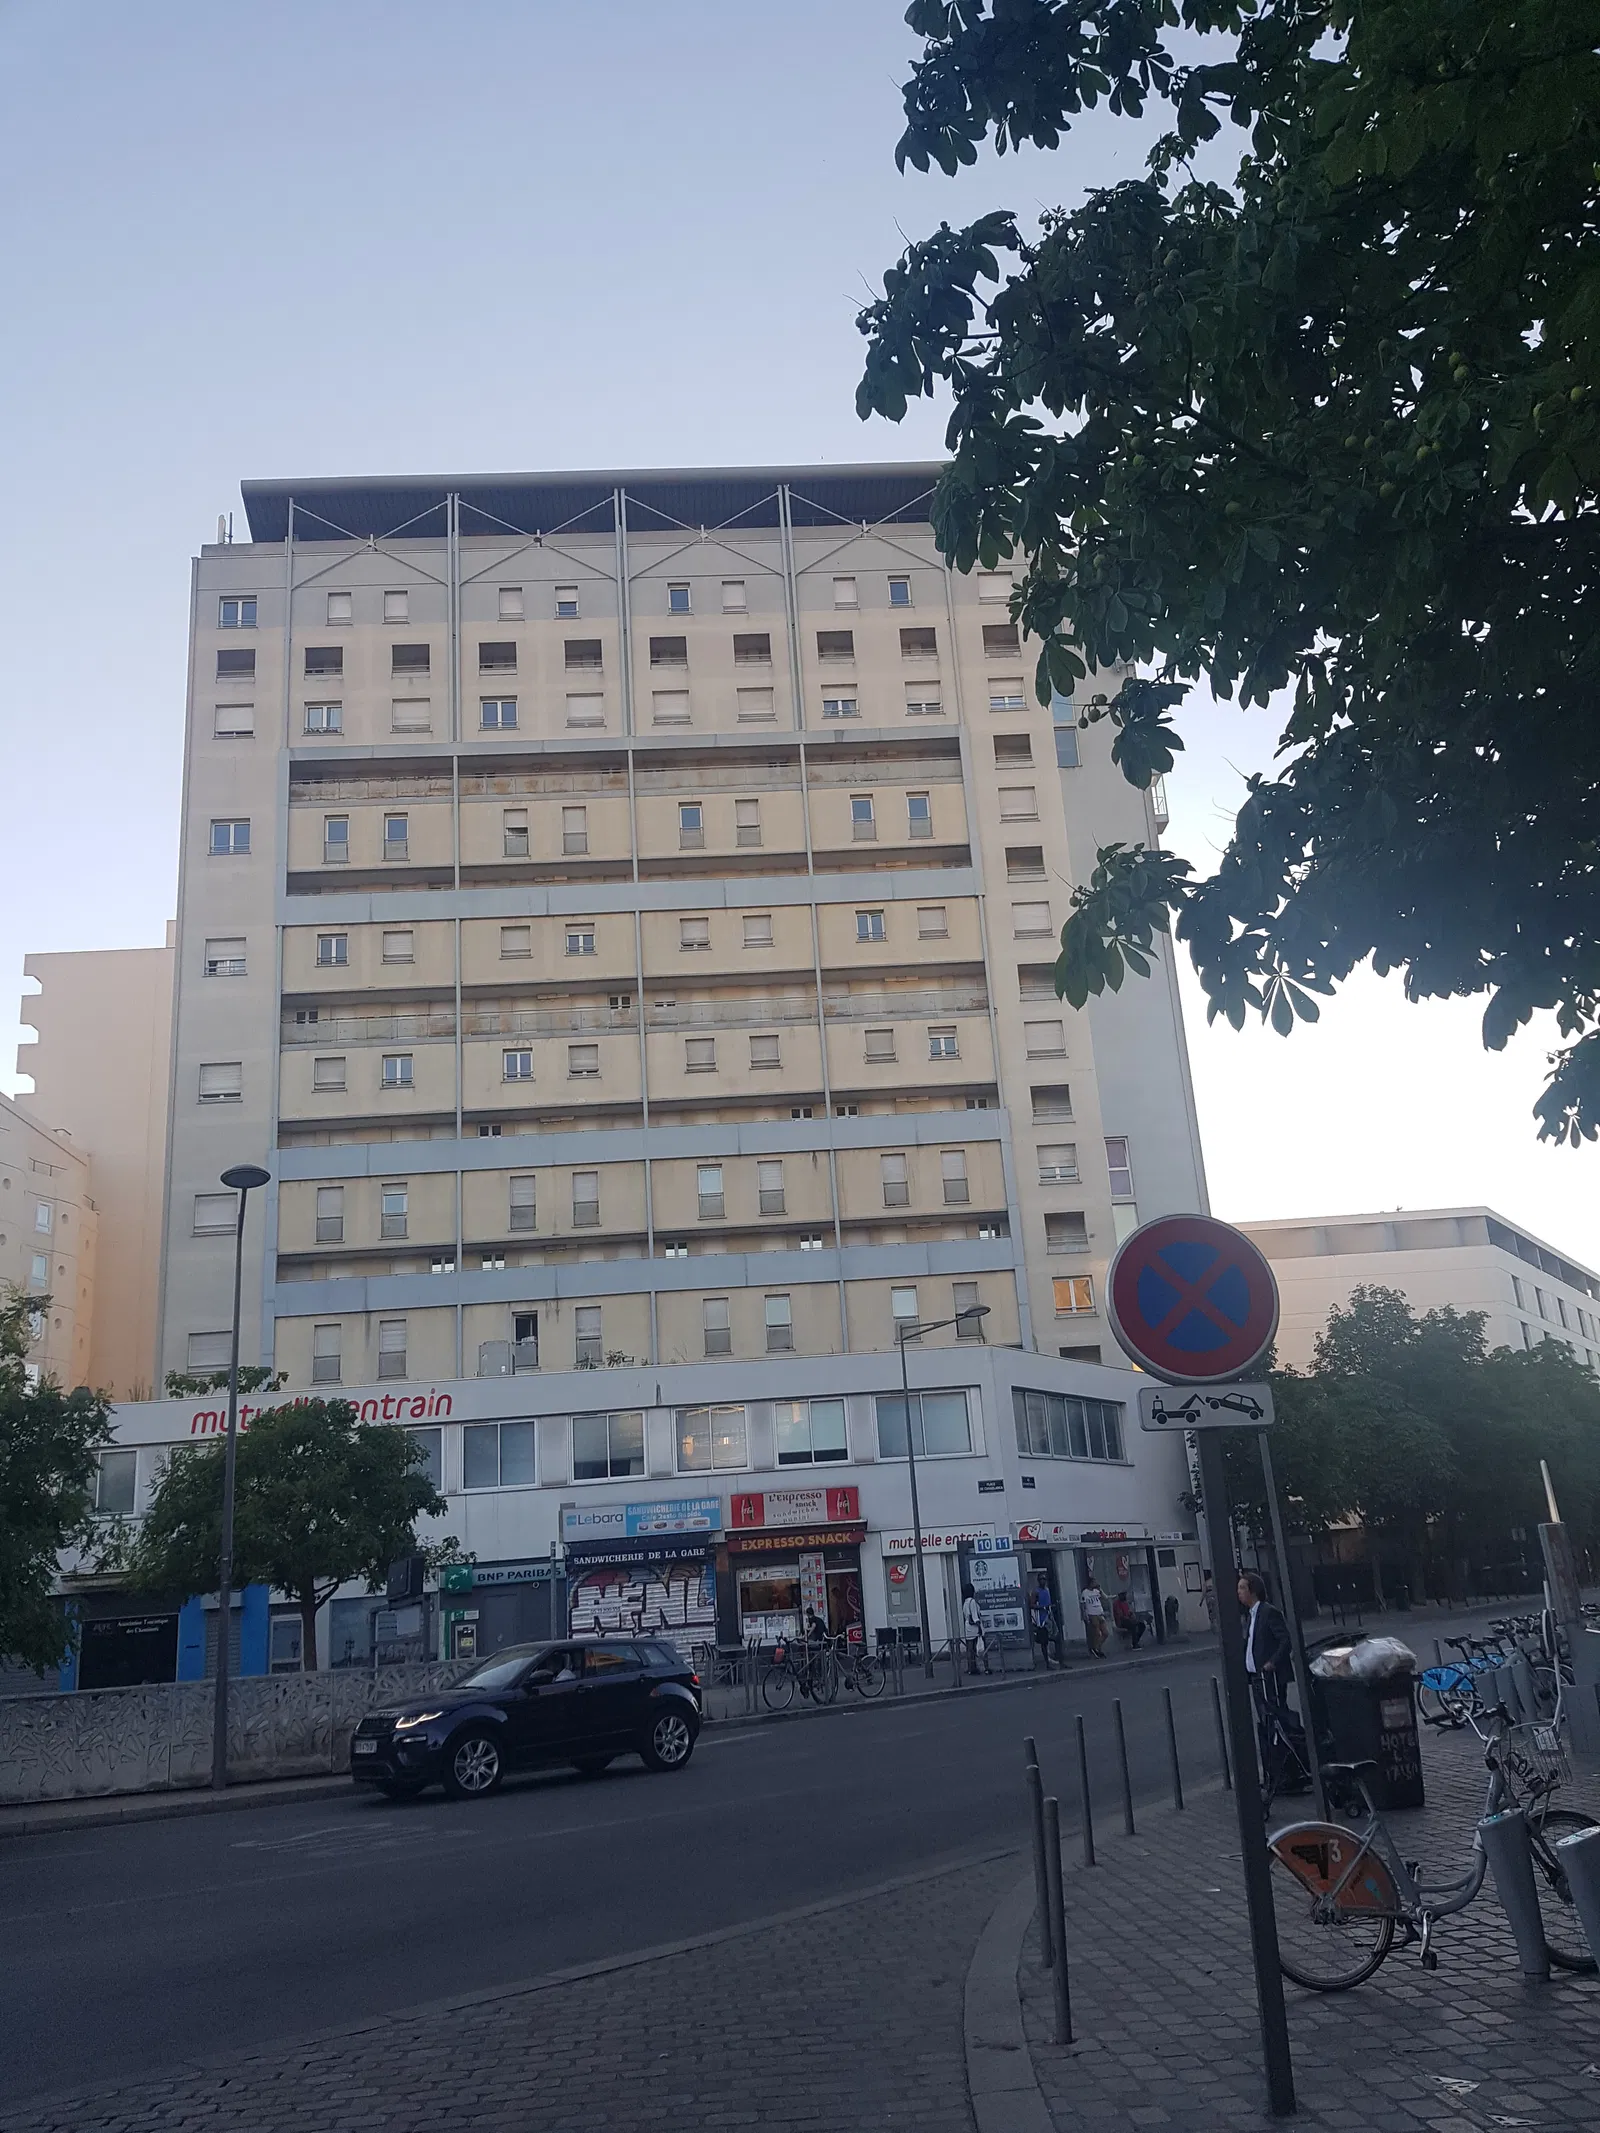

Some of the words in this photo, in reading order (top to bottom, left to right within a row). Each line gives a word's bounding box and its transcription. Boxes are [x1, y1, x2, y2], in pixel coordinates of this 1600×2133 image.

[627, 1503, 680, 1515] SANDWICHERIE
[691, 1501, 700, 1510] LA
[701, 1500, 719, 1509] GARE
[577, 1513, 624, 1525] Lebara
[741, 1536, 804, 1550] EXPRESSO
[808, 1532, 851, 1545] SNACK
[889, 1534, 942, 1550] mutelle
[978, 1540, 991, 1550] 10
[996, 1538, 1008, 1549] 11
[574, 1553, 644, 1565] SANDWICHERIE
[648, 1551, 661, 1560] DE
[665, 1550, 677, 1559] LA
[681, 1548, 705, 1557] GARE
[477, 1573, 503, 1581] BNP
[507, 1567, 561, 1579] PARIBAS
